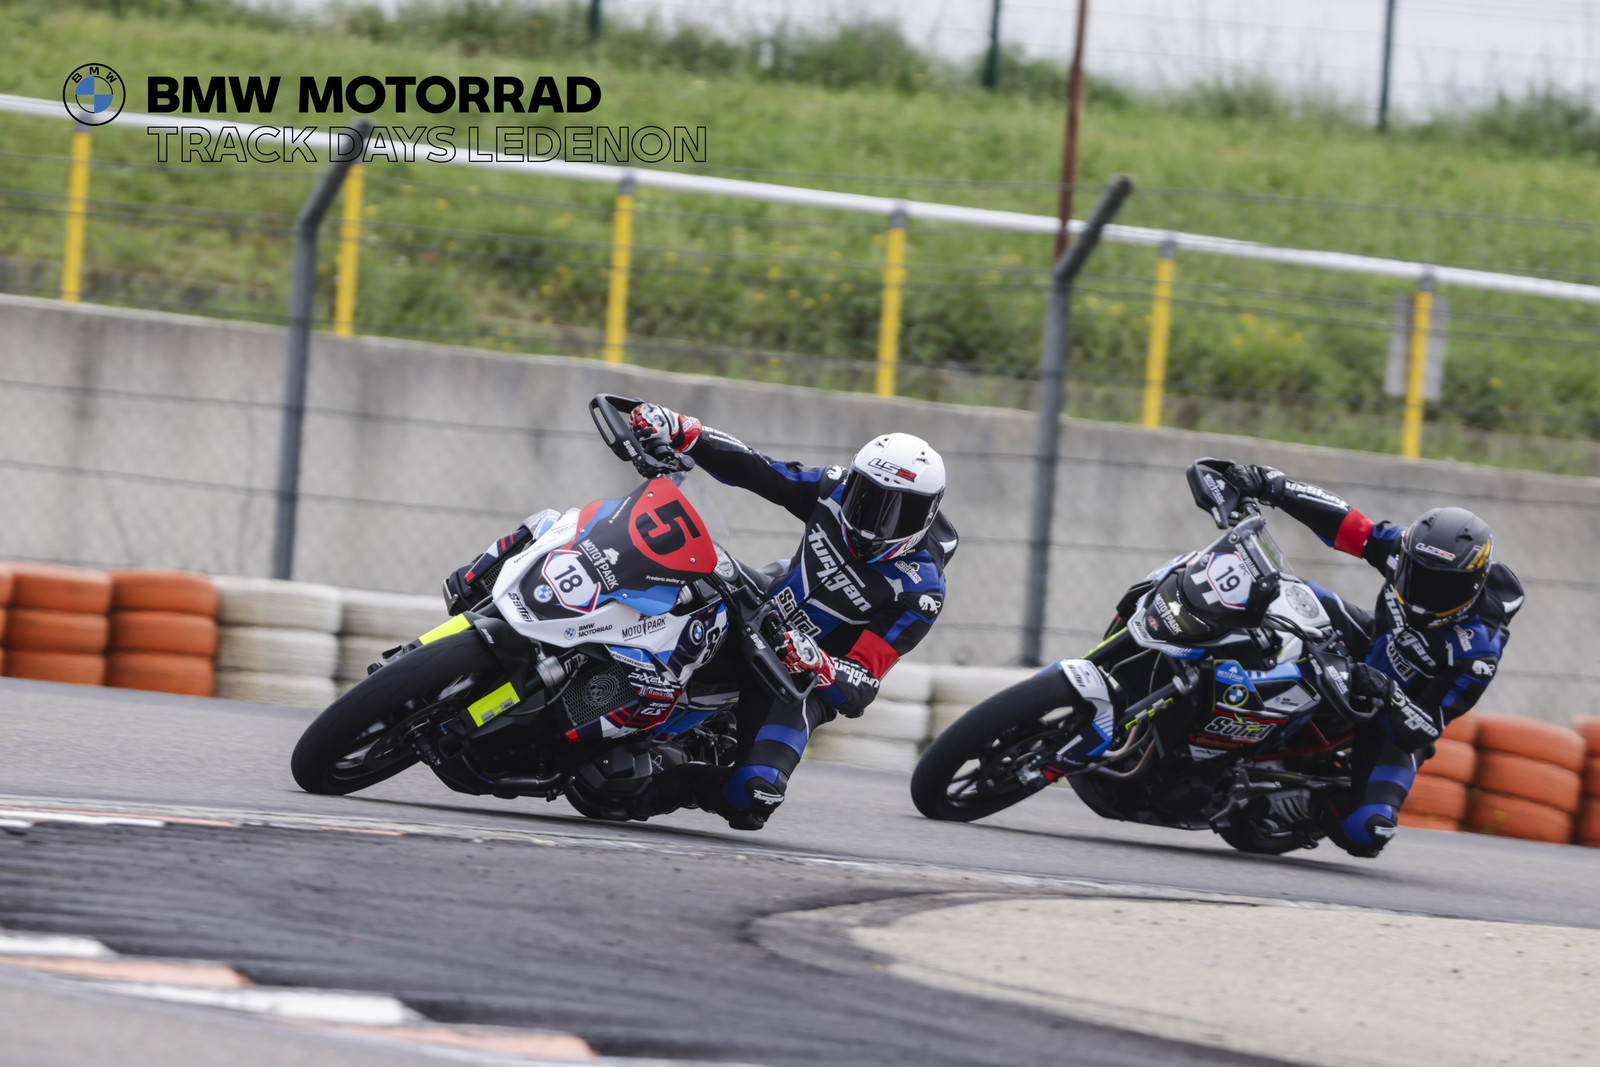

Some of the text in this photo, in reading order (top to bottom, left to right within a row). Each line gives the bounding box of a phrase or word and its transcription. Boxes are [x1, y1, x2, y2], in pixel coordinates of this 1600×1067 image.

[867, 458, 917, 483] LS2
[635, 499, 702, 556] 5
[581, 538, 620, 590] MOTO PARK
[808, 522, 872, 613] Furygan
[553, 564, 584, 594] 18
[1215, 565, 1241, 593] 19
[579, 623, 595, 631] BMW
[622, 617, 666, 639] MOTO PARK
[1154, 592, 1183, 635] MOTO PARK
[578, 625, 613, 638] MOTORRAD
